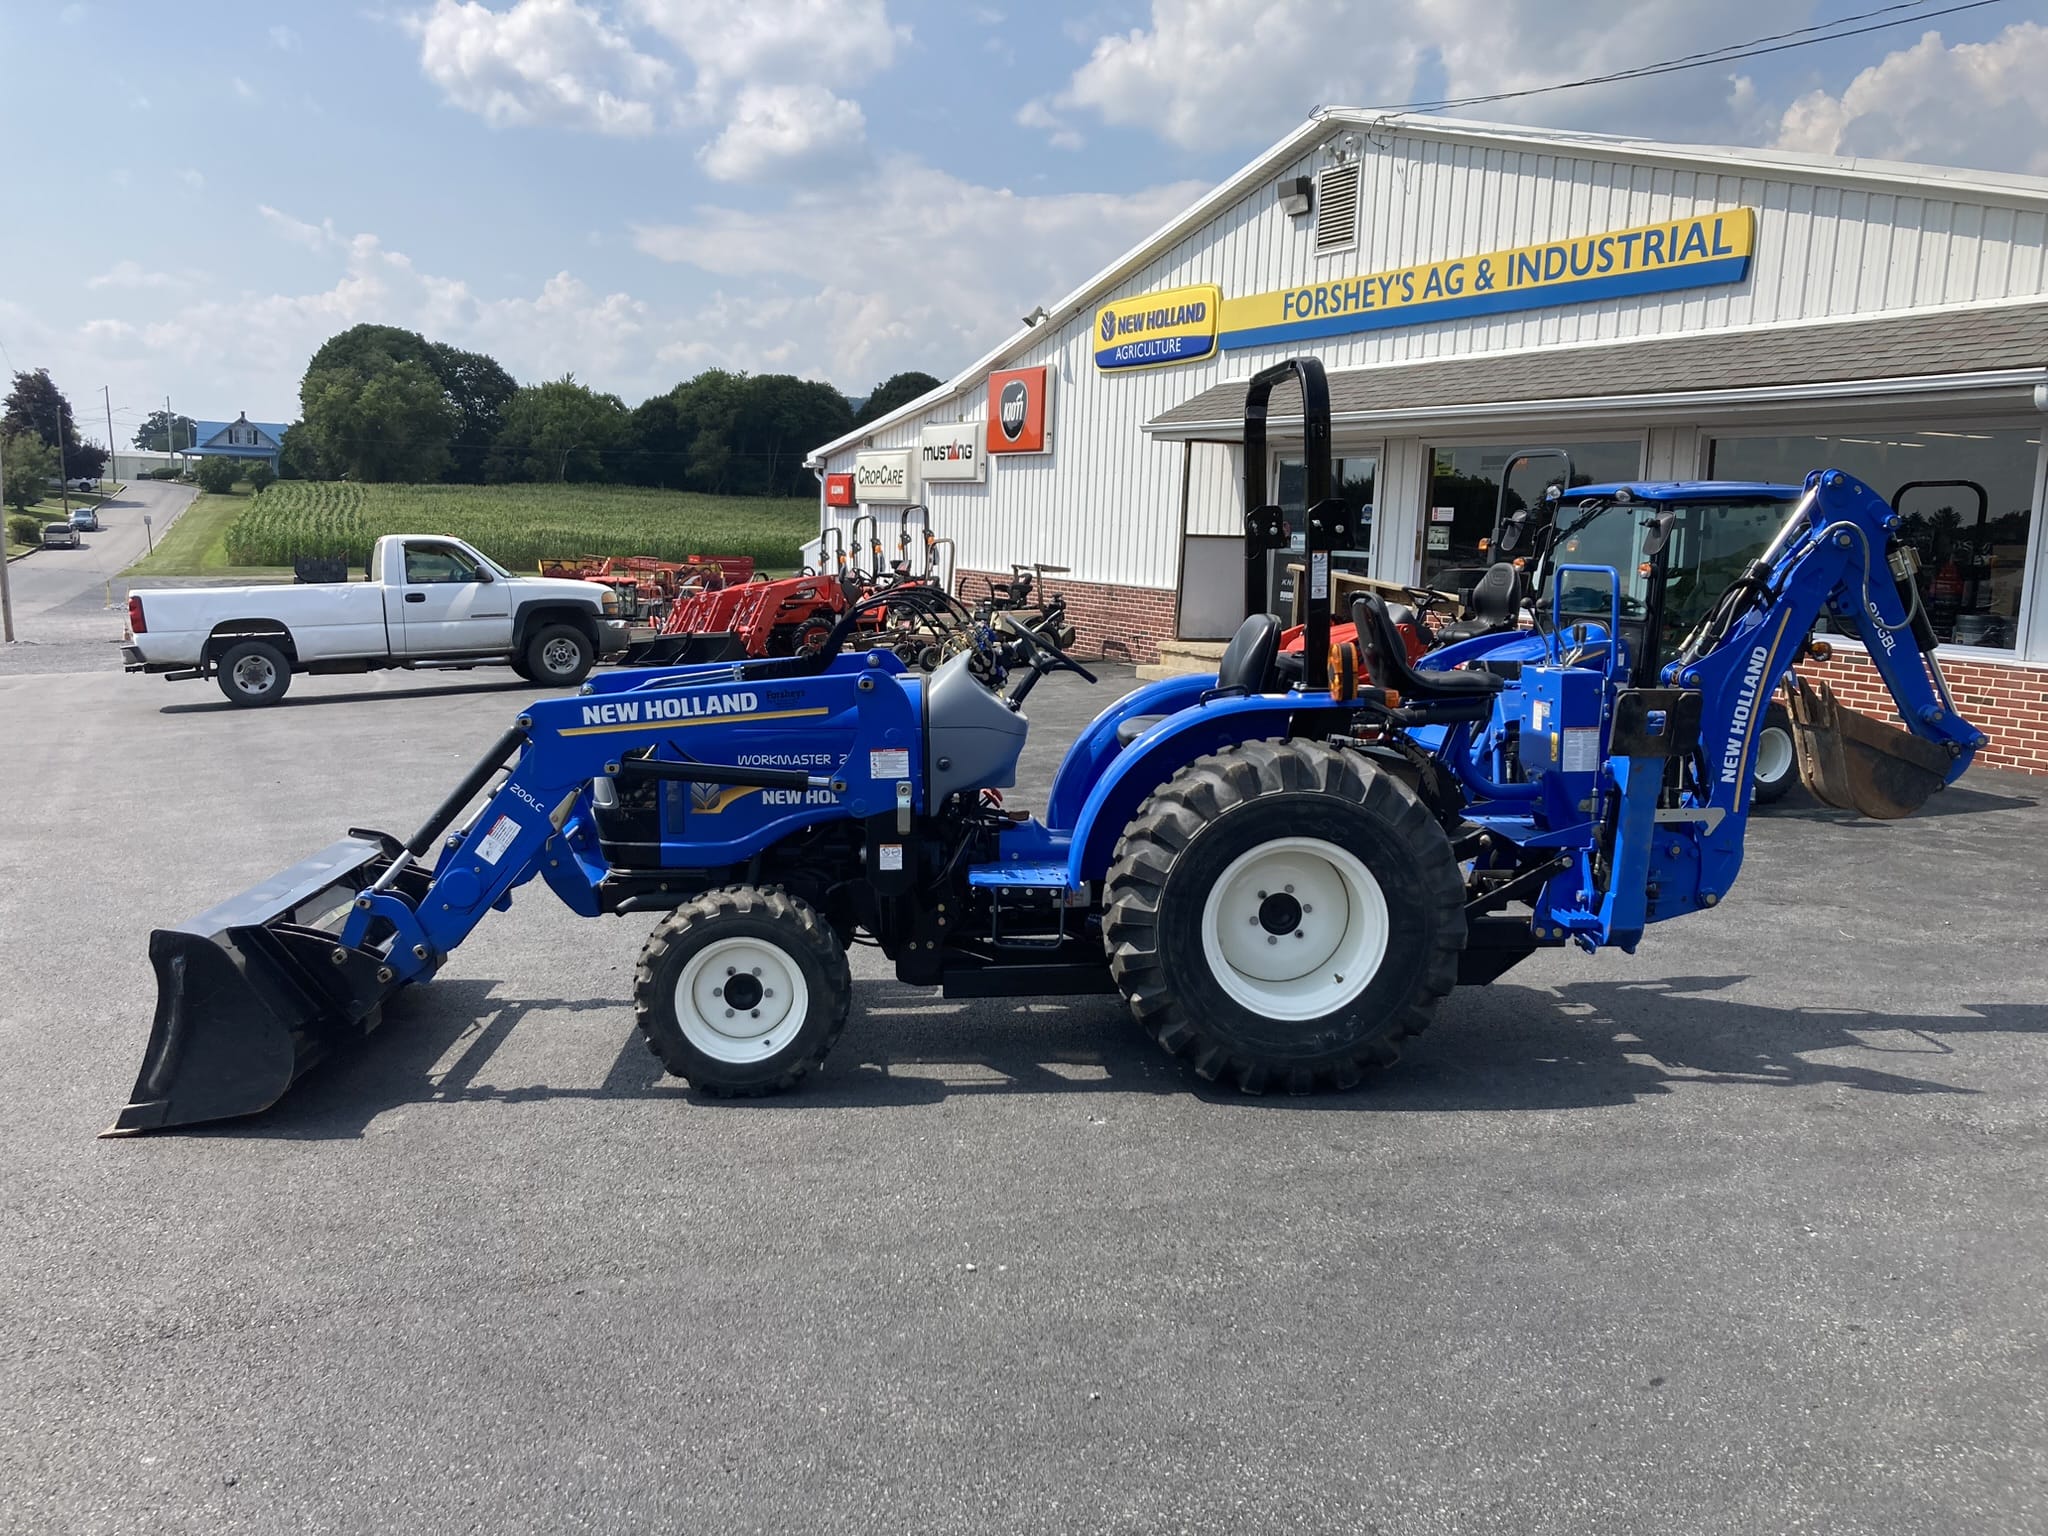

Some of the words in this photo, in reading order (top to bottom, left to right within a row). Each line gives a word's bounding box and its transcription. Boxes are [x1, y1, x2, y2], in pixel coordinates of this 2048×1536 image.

[1282, 271, 1415, 321] FORSHEY'S
[1422, 262, 1465, 299] AG
[1474, 258, 1495, 291] &
[1506, 218, 1733, 288] INDUSTRIAL
[1117, 311, 1147, 336] NEW
[1146, 301, 1206, 331] HOLLAND
[1115, 337, 1182, 361] AGRICULTURE
[1003, 389, 1024, 422] KIOTI
[1729, 646, 1769, 735] HOLLAND
[582, 702, 639, 725] NEW
[644, 692, 758, 720] HOLLAND
[737, 754, 832, 766] WORKMASTER
[1720, 737, 1743, 783] NEW
[509, 782, 545, 813] 200LC
[762, 790, 802, 805] NEW
